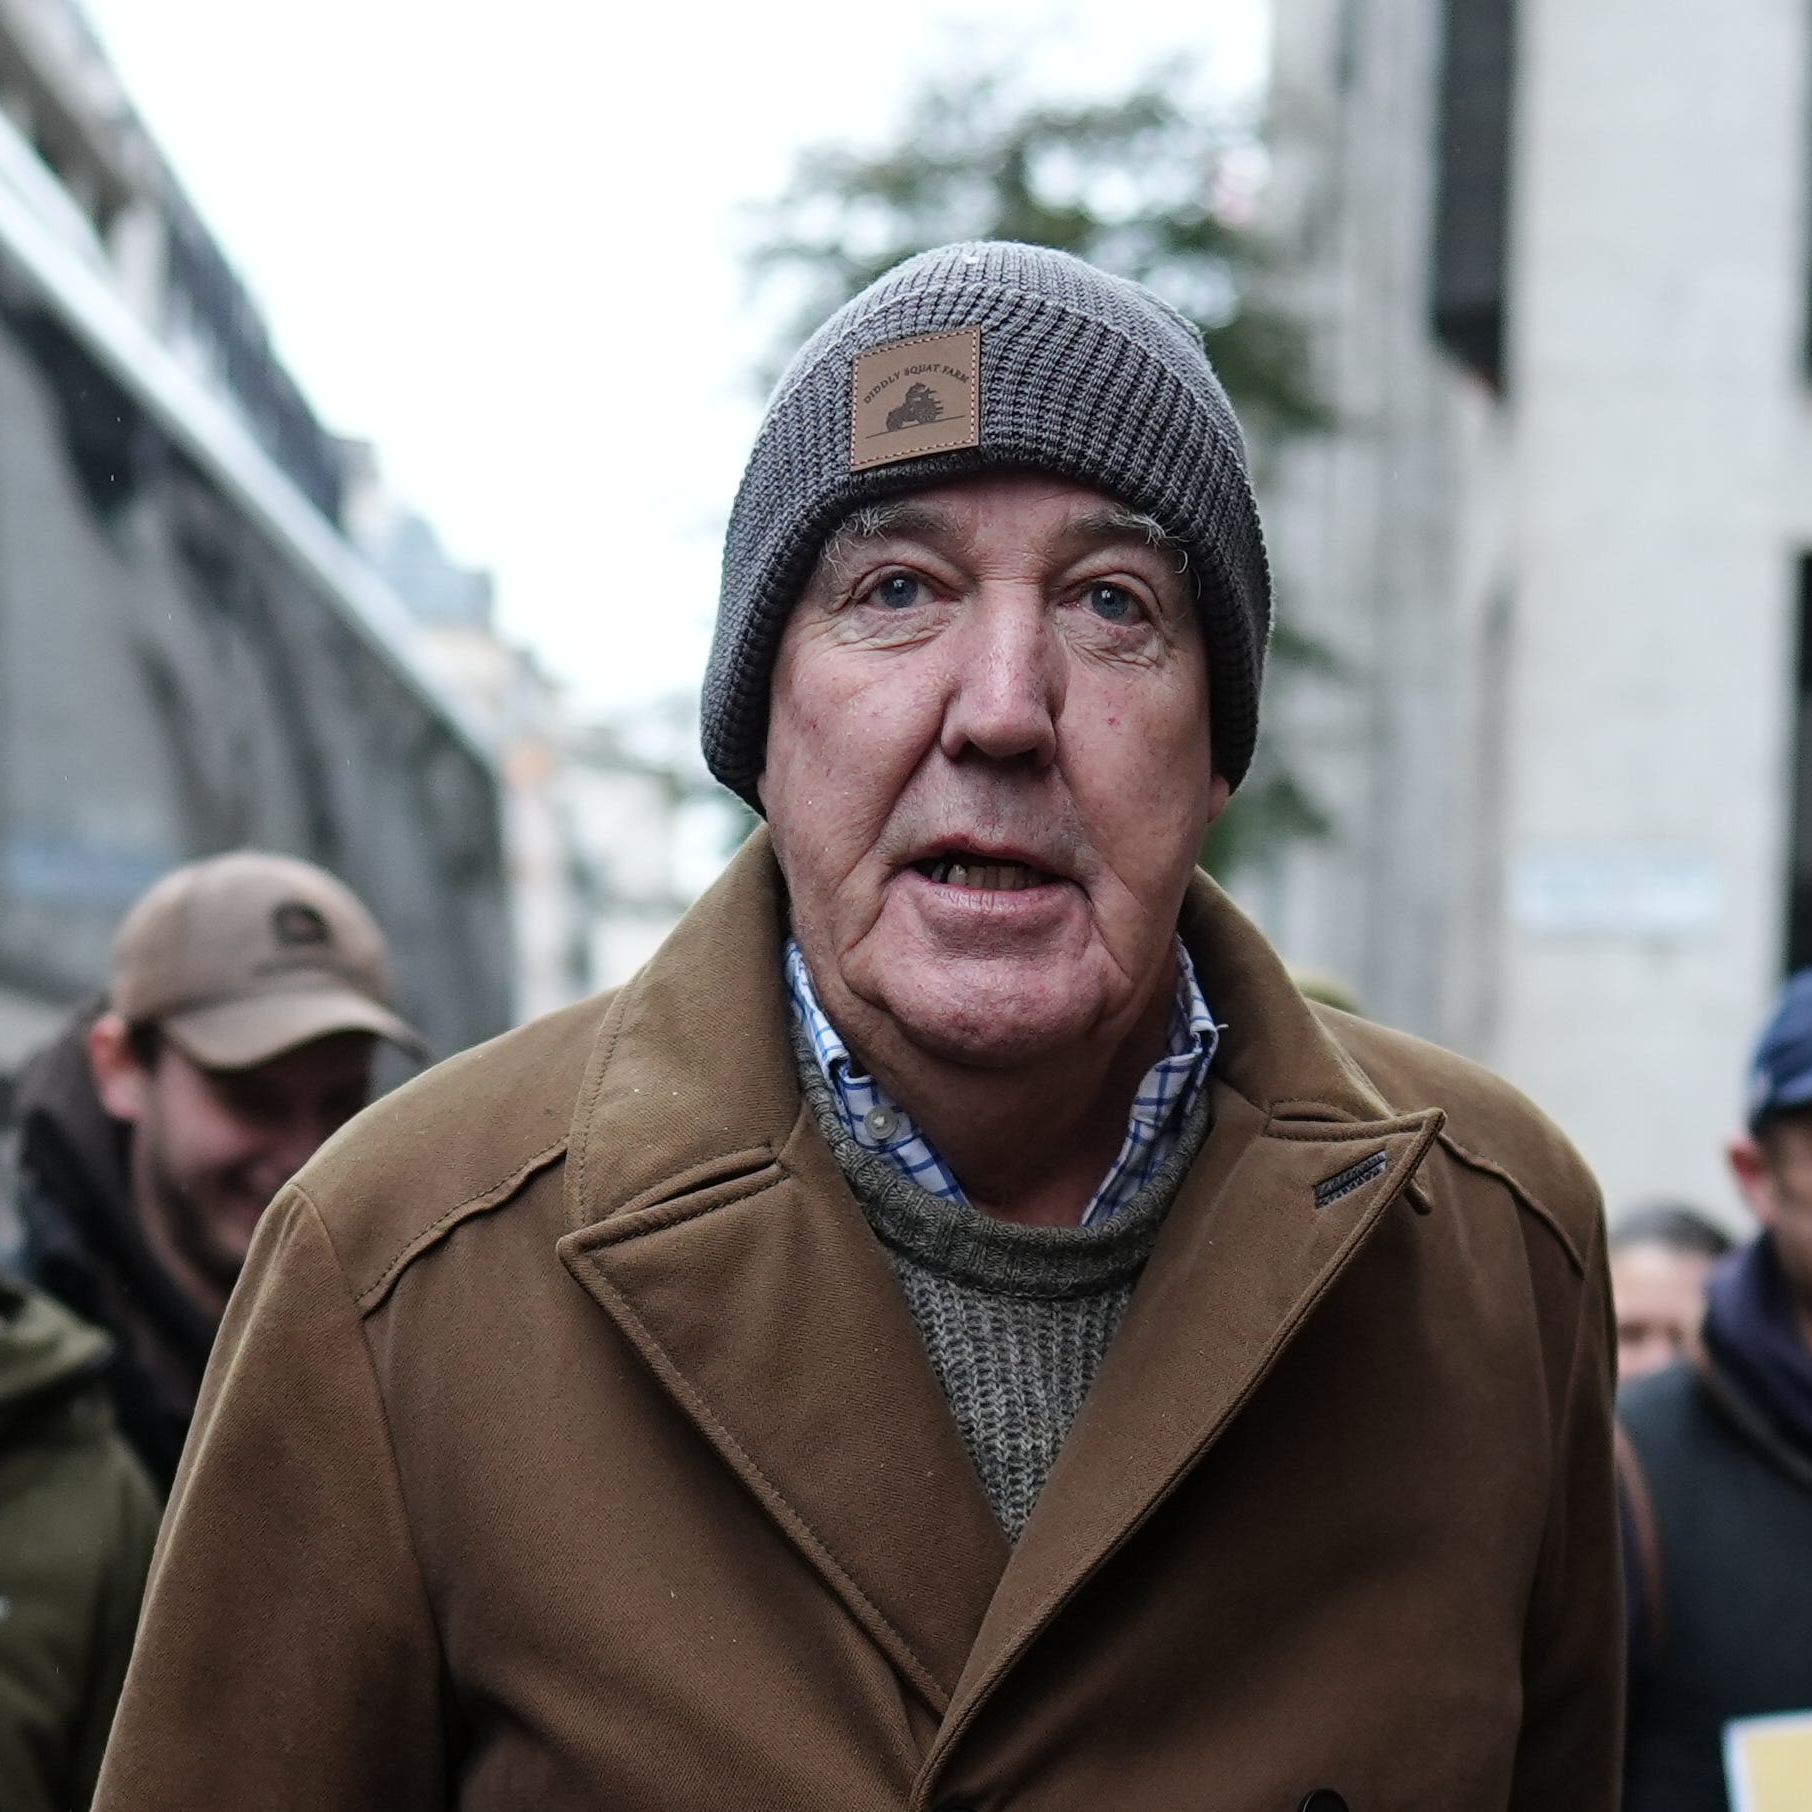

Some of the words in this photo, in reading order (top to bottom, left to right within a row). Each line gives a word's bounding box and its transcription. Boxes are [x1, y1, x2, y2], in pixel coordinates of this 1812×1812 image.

[863, 371, 901, 404] DIDDLY
[904, 364, 941, 376] SQUAT
[942, 366, 969, 384] FARM
